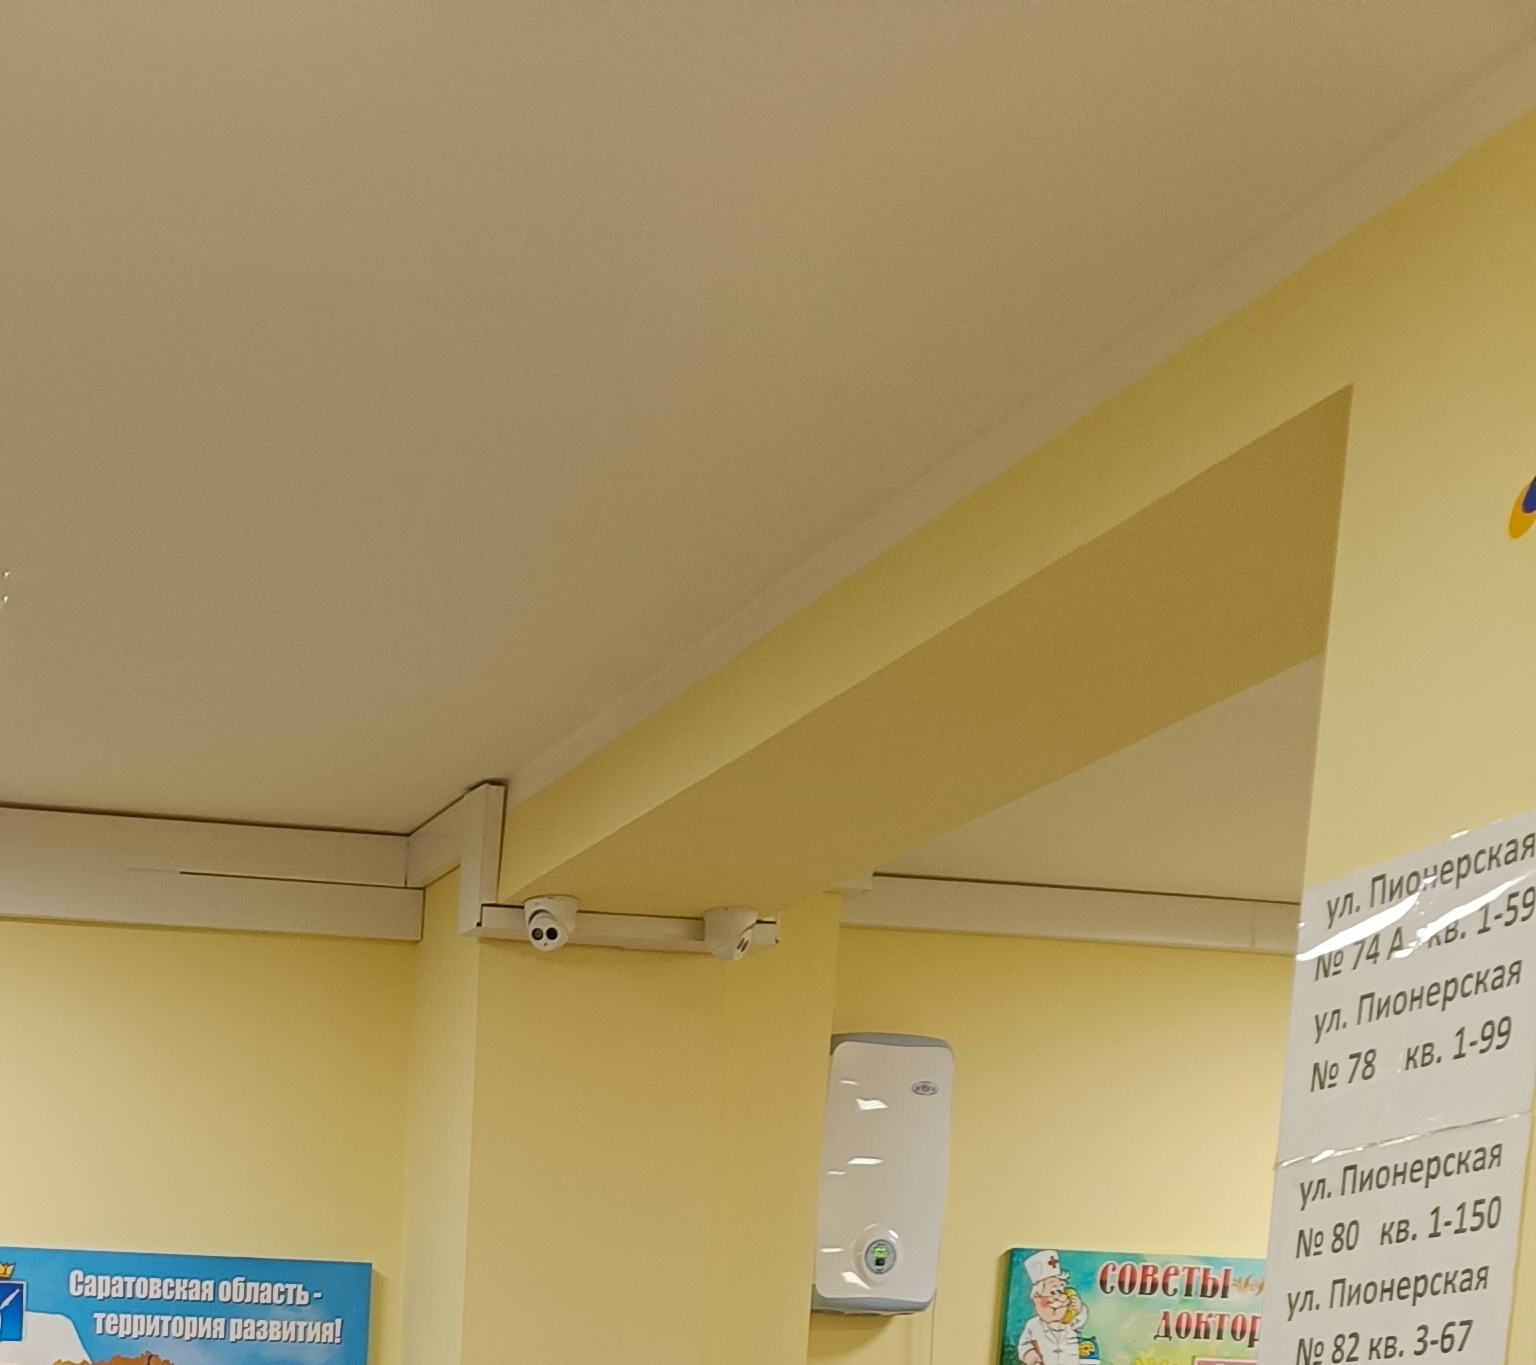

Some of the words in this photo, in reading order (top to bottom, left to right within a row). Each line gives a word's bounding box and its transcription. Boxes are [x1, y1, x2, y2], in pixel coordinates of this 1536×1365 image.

[1327, 892, 1361, 930] ул.
[1370, 832, 1536, 908] Пионерская
[1315, 951, 1344, 981] №
[1352, 933, 1380, 970] 74
[1386, 927, 1404, 960] А
[1477, 886, 1536, 935] 1-59
[1315, 1009, 1347, 1044] ул.
[1357, 960, 1522, 1025] Пионерская
[1311, 1061, 1338, 1092] №
[1348, 1049, 1376, 1083] 78
[1405, 1043, 1441, 1070] кв.
[1453, 1016, 1511, 1059] 1-99
[1300, 1178, 1331, 1211] ул.
[1341, 1144, 1502, 1195] Пионерская
[1296, 1228, 1323, 1258] №
[1332, 1220, 1359, 1253] 80
[1380, 1220, 1417, 1245] кв.
[1429, 1196, 1501, 1238] 1-150
[69, 1270, 214, 1300] Саратовская
[219, 1276, 310, 1305] область
[1288, 1290, 1319, 1321] ул.
[1330, 1266, 1489, 1308] Пионерская
[93, 1312, 226, 1340] территория
[229, 1318, 342, 1344] развития!
[1296, 1338, 1324, 1365] №
[1332, 1332, 1359, 1364] 82
[1369, 1336, 1403, 1360] кв.
[1414, 1320, 1473, 1355] 3-67
